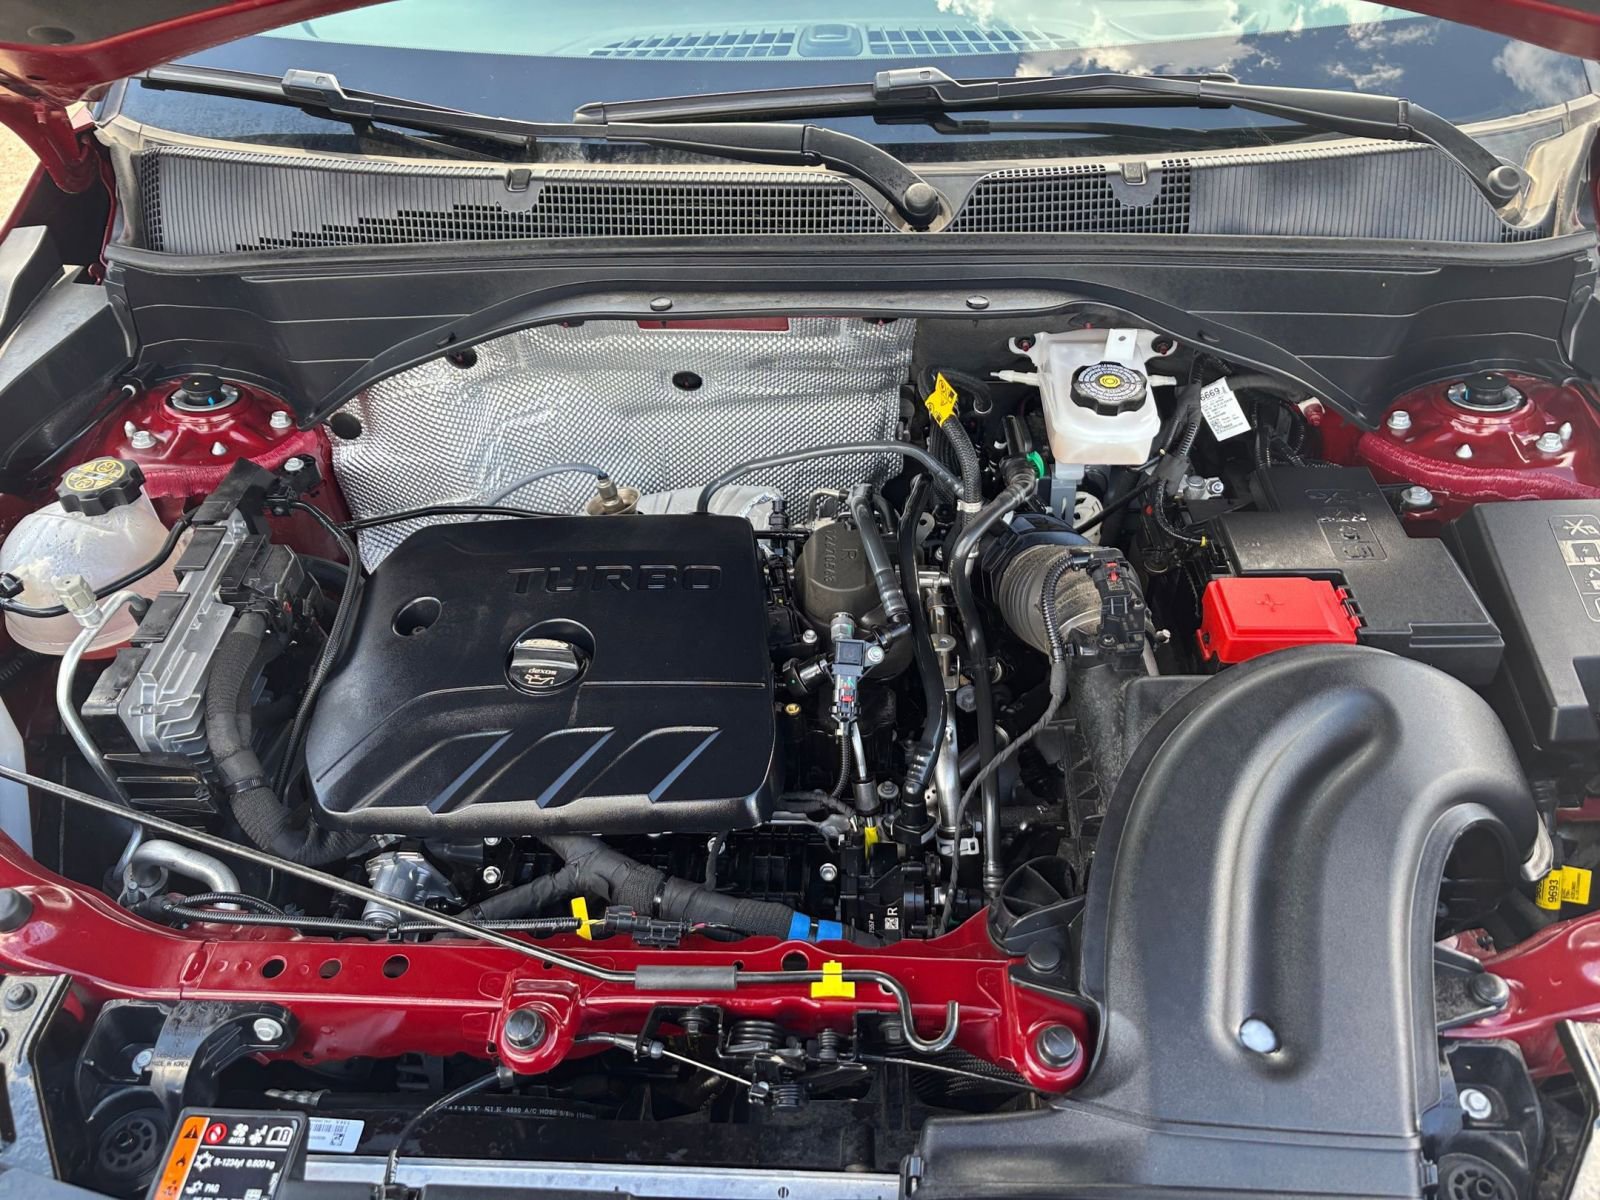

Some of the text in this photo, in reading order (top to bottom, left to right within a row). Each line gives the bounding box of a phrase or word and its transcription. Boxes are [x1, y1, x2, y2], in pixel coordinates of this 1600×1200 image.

[507, 564, 722, 594] TURBO
[528, 667, 558, 675] dexos
[1547, 879, 1559, 903] 9693
[887, 906, 898, 916] R
[539, 1108, 557, 1116] HOSE
[228, 1137, 246, 1145] AUTO
[213, 1157, 246, 1169] R-1234yf
[266, 1160, 276, 1170] kg
[203, 1183, 220, 1194] PAG
